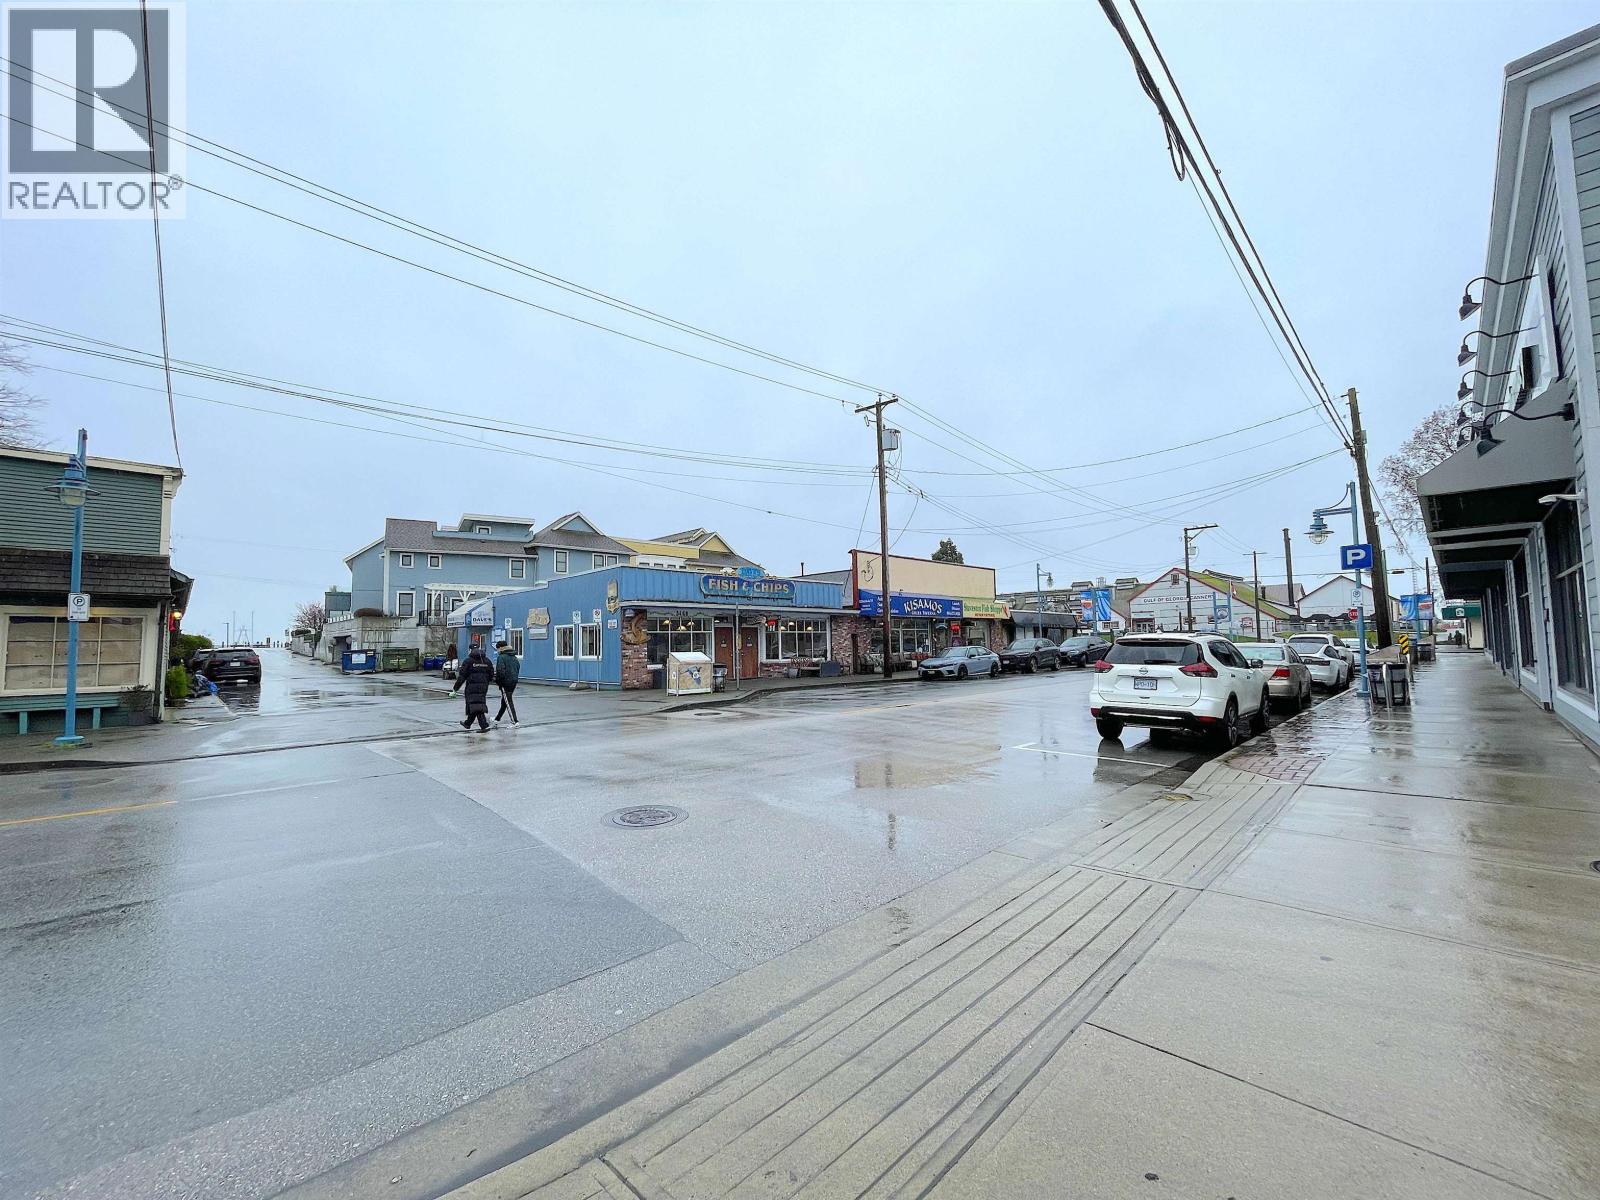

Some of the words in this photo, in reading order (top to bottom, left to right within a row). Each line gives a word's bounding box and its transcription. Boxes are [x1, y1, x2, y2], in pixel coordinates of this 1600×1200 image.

[1346, 549, 1366, 566] P
[708, 578, 738, 591] FISH
[742, 581, 750, 591] &
[753, 582, 789, 594] CHIPS
[903, 598, 943, 615] KISAMOS
